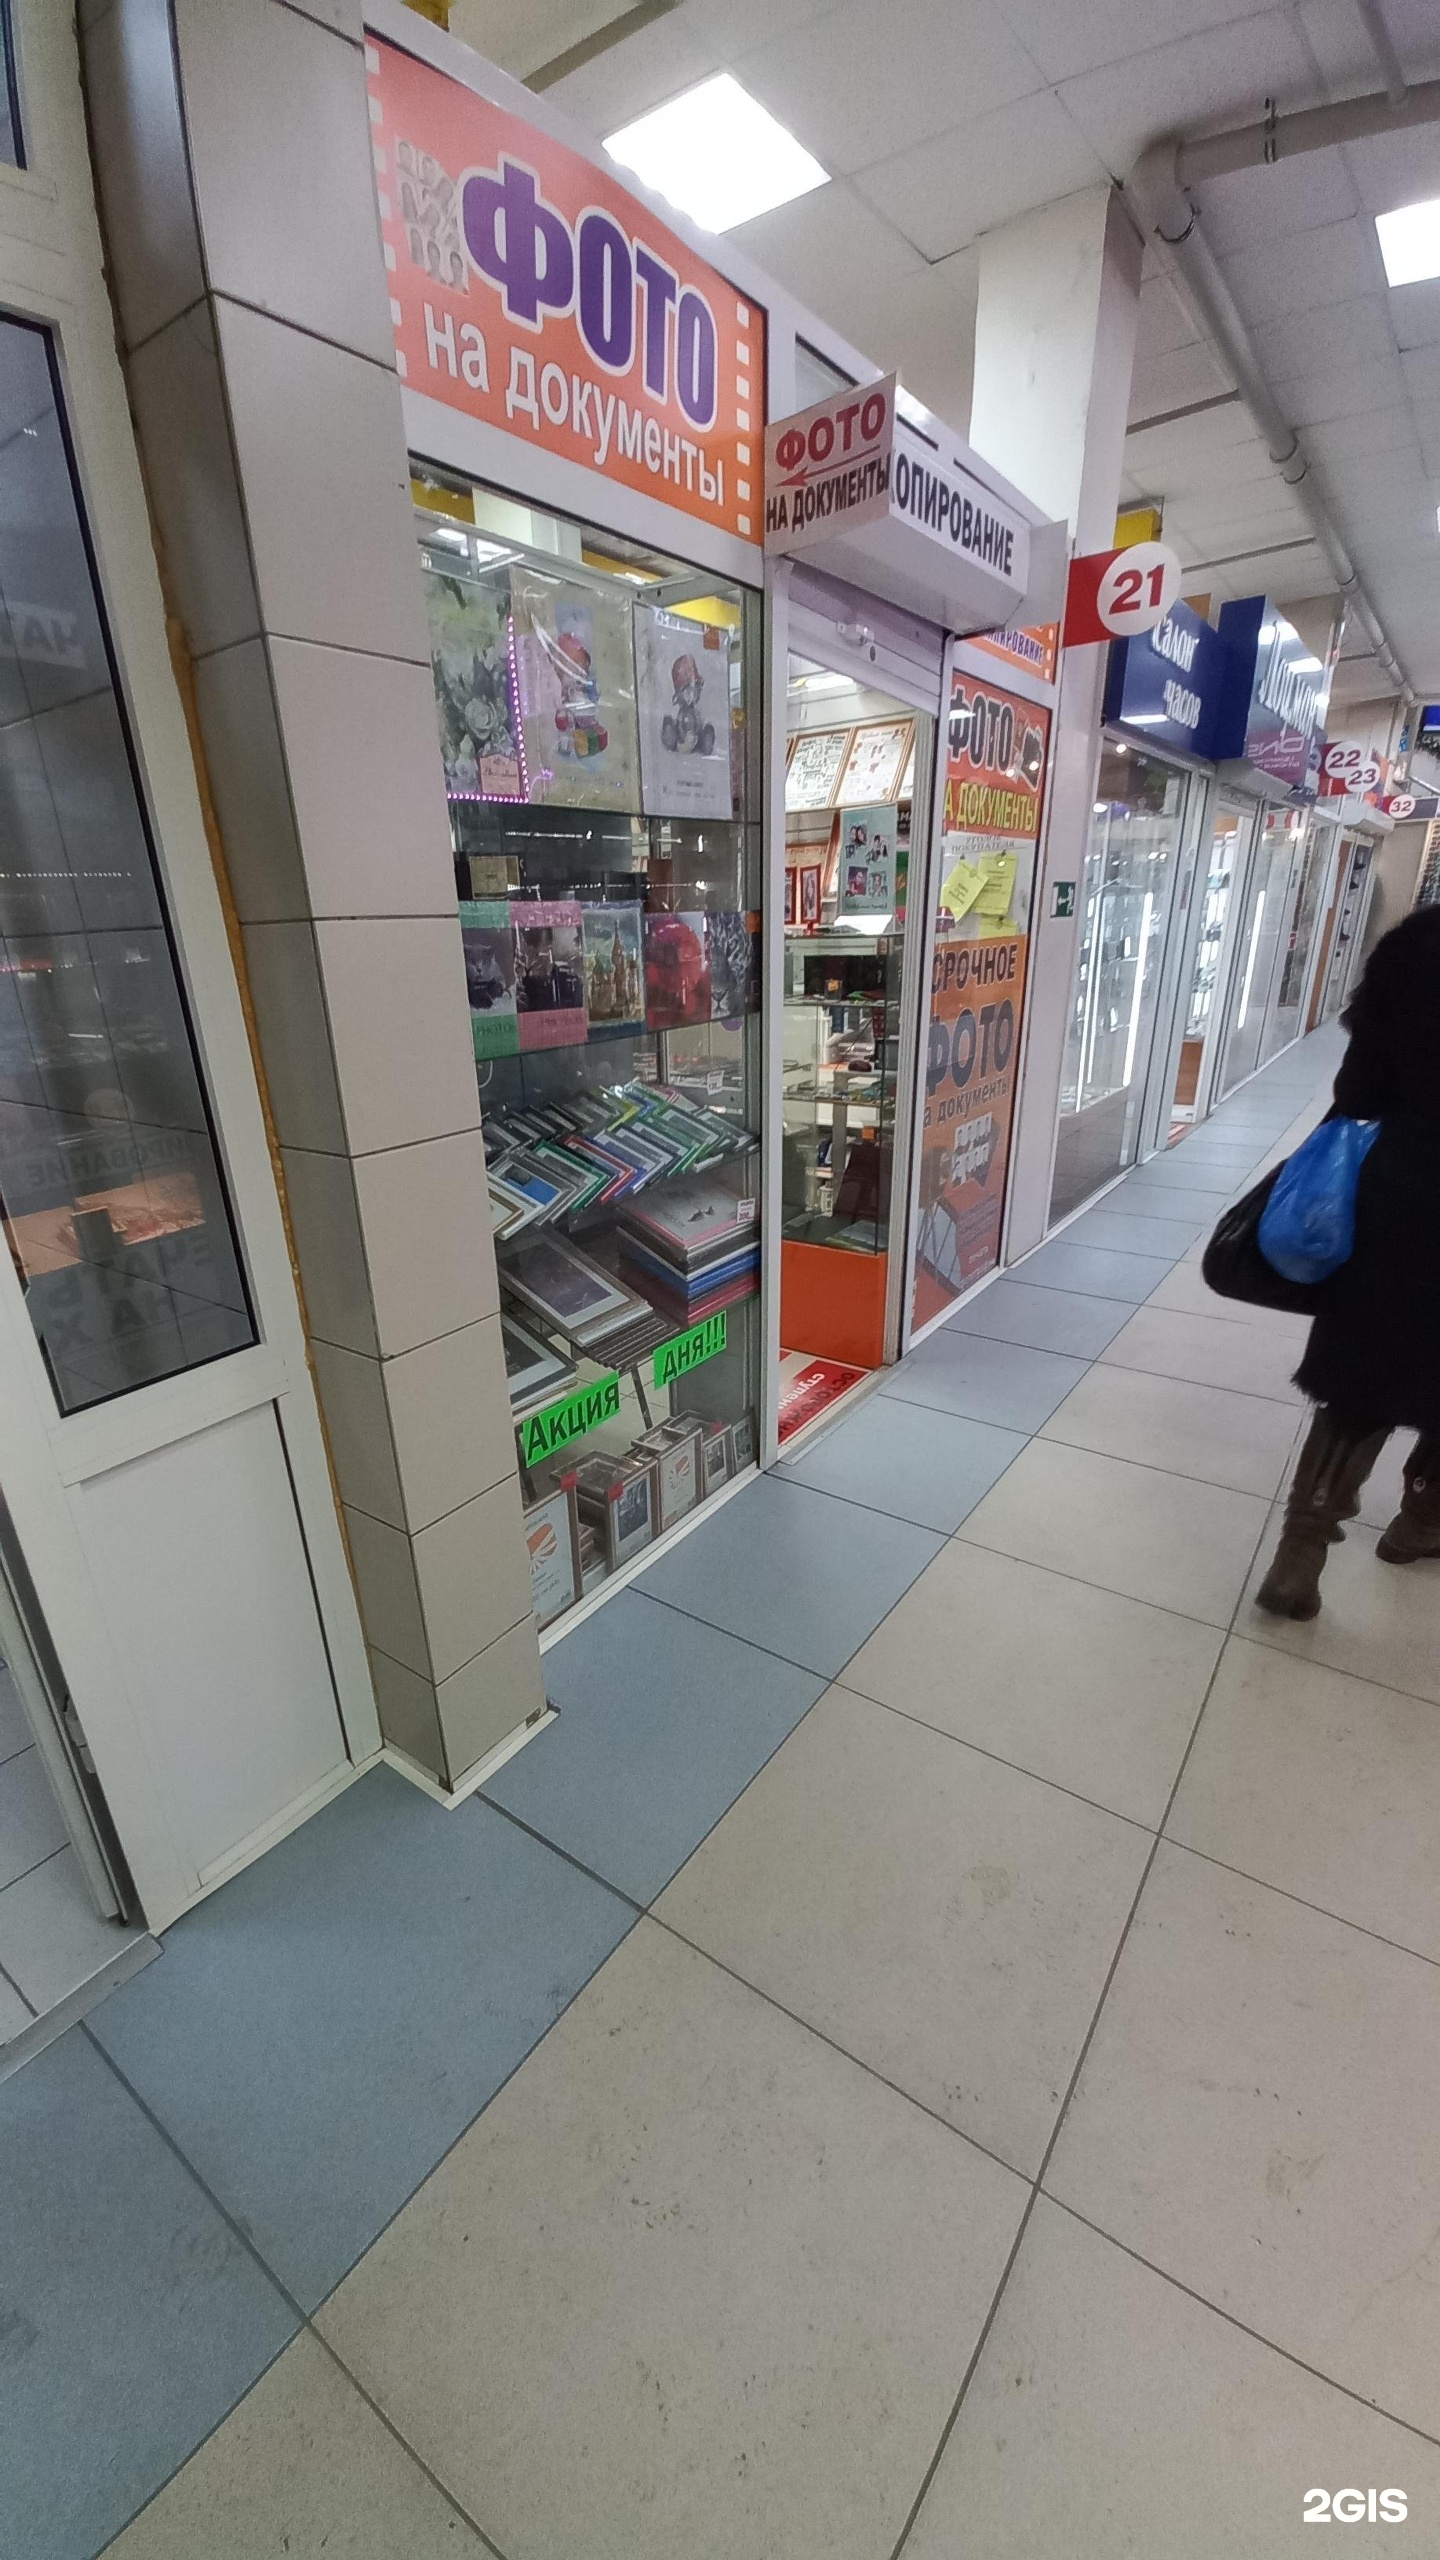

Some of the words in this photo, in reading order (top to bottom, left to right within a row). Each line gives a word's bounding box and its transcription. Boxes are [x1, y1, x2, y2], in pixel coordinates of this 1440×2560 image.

[460, 155, 717, 430] ФОТО
[422, 302, 490, 393] на
[506, 346, 725, 506] документы
[775, 391, 886, 472] ФОТО
[766, 489, 787, 534] НА
[791, 452, 892, 532] ДОКУМЕНТЫ
[891, 452, 1014, 577] ОПИРОВАНИЕ
[1108, 564, 1165, 615] 21
[987, 631, 1044, 667] ИРОВАНИЕ
[949, 687, 1014, 771] ФОТО
[1163, 679, 1201, 729] часов
[1328, 749, 1362, 769] 22
[1348, 768, 1377, 787] 23
[943, 779, 954, 822] А
[956, 782, 1039, 832] ДОКУМЕНТЫ
[1391, 800, 1412, 813] 32
[932, 944, 1018, 995] СРОЧНОЕ
[926, 999, 1015, 1098] ФОТО
[923, 1104, 932, 1129] а
[527, 1380, 621, 1462] Акция
